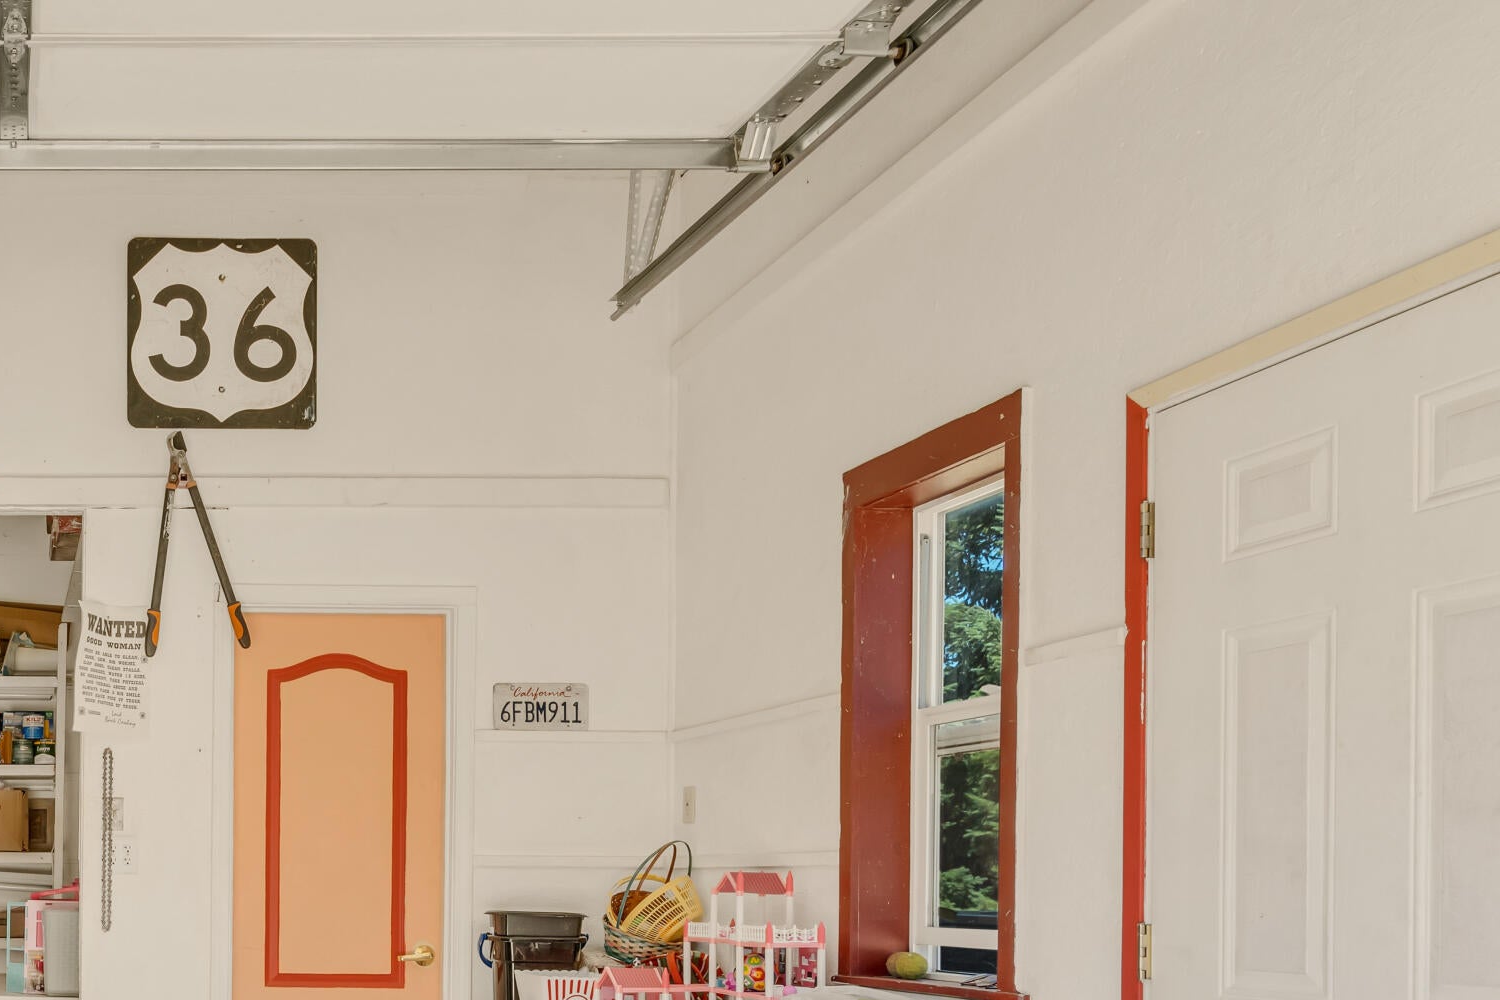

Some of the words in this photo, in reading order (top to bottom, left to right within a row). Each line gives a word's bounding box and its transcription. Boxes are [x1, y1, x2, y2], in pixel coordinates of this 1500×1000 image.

[148, 283, 297, 382] 36
[88, 612, 147, 638] WANTED
[86, 636, 103, 646] GOOD
[107, 641, 142, 650] WOMAN
[513, 686, 571, 701] California
[500, 701, 582, 723] 6FBM911
